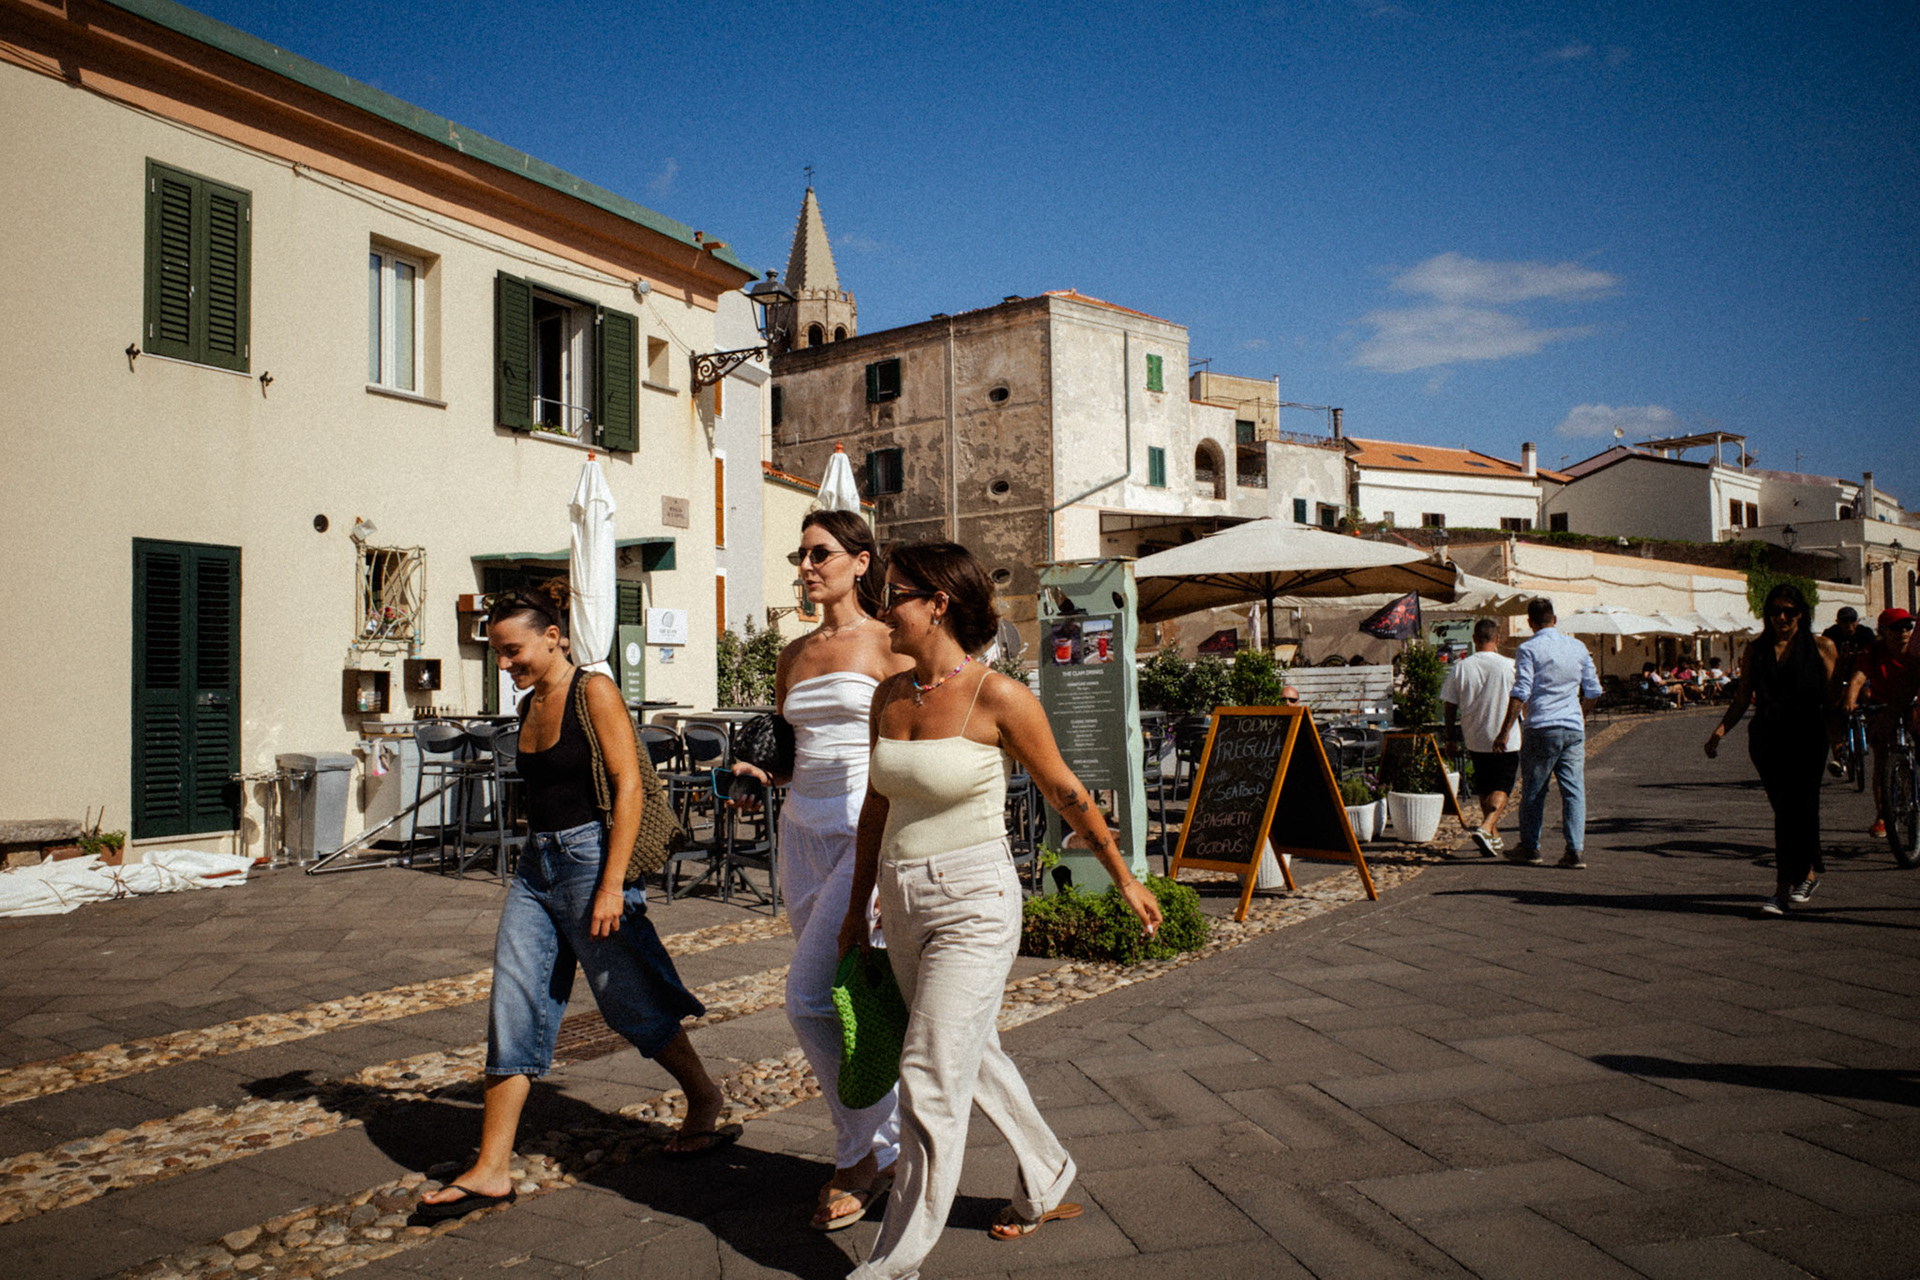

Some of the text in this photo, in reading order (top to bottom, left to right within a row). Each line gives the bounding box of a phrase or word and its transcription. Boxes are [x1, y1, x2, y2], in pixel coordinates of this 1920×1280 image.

[1236, 717, 1281, 735] TODAY:
[1215, 728, 1282, 766] FREGULA
[1191, 811, 1252, 833] SPAGHETTI
[1196, 838, 1243, 855] OCTOPUS
